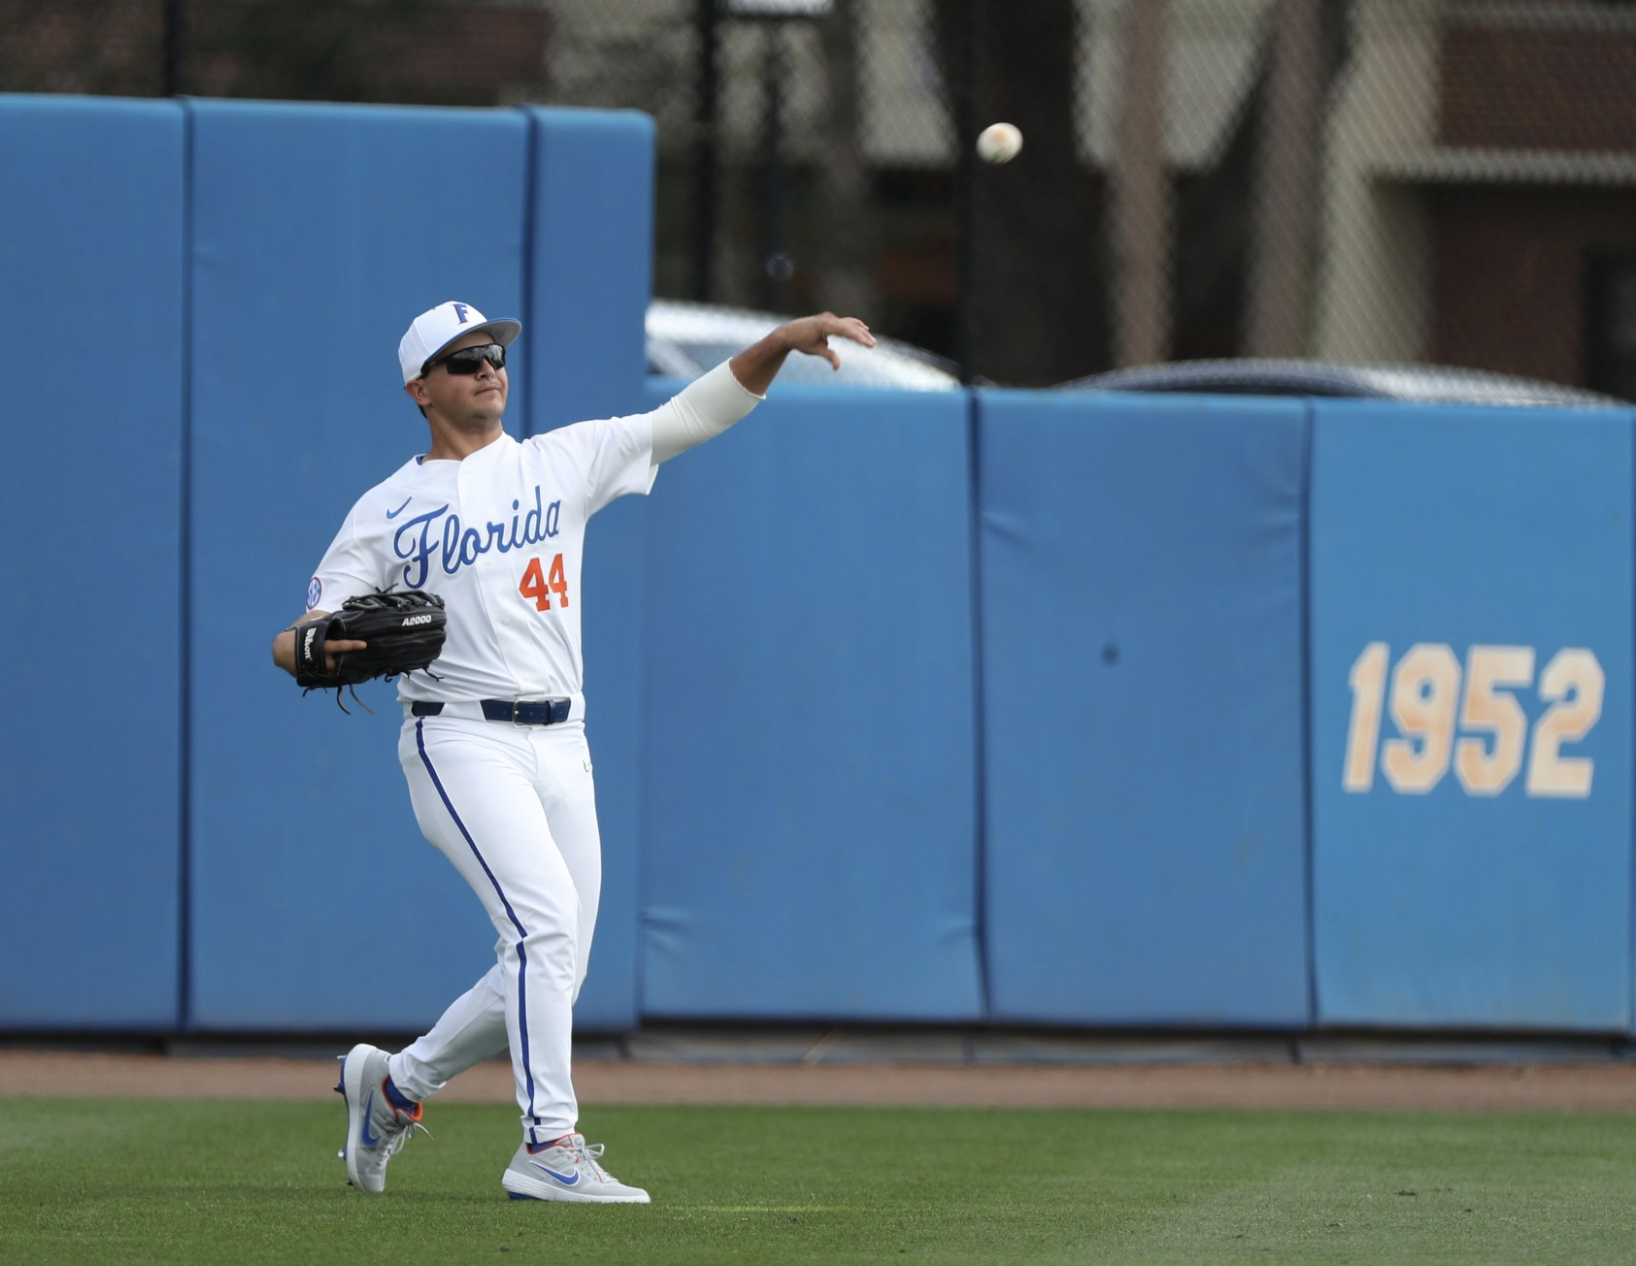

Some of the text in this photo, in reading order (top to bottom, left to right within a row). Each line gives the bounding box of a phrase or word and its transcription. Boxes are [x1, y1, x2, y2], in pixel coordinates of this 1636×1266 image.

[453, 304, 469, 325] F
[393, 485, 561, 589] Florida
[519, 553, 569, 612] 44
[402, 614, 432, 627] A2000
[1342, 641, 1606, 799] 1952
